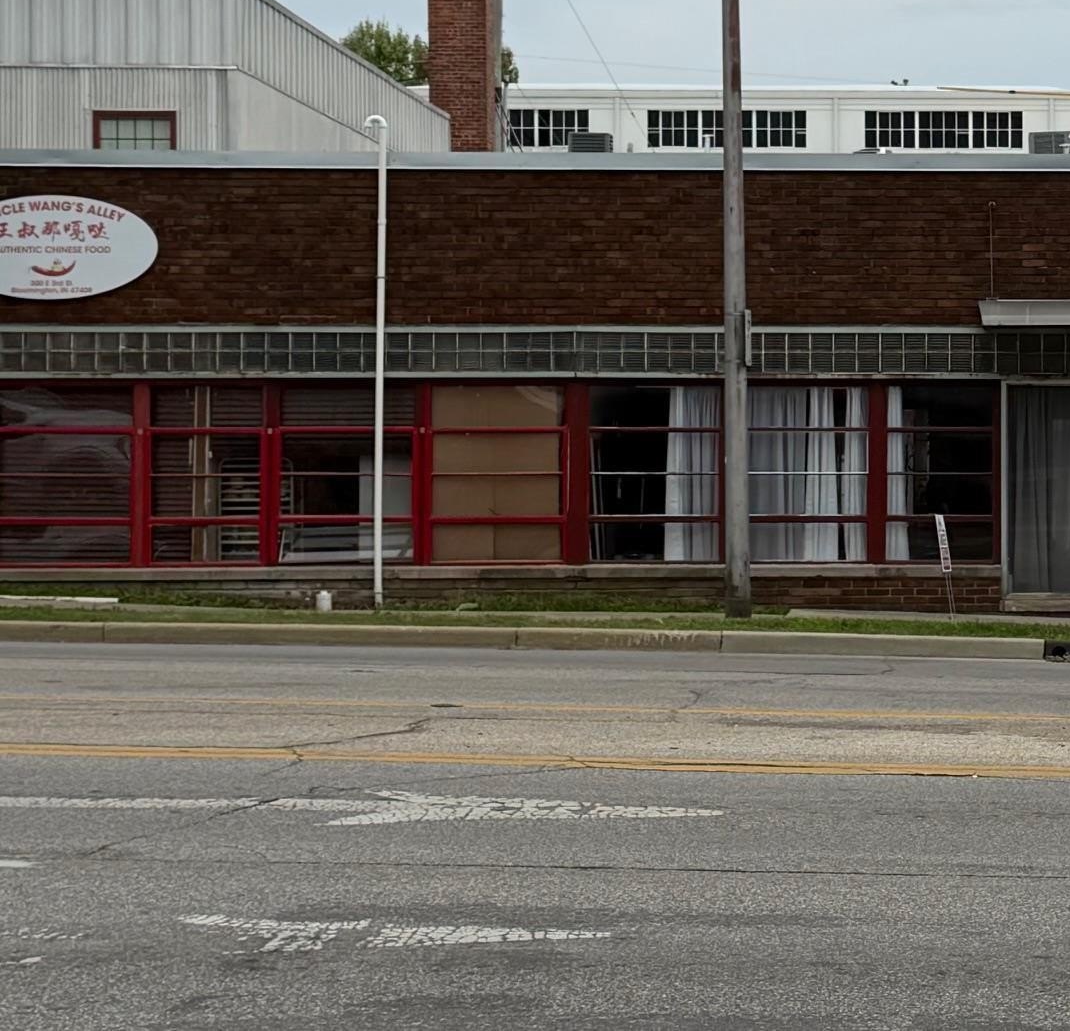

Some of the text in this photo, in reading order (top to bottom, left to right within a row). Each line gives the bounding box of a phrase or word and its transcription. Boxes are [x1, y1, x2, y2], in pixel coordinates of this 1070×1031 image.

[0, 201, 125, 222] CLE WANG'S ALLEY
[0, 246, 111, 254] UTHENTIC CHINESE FOOD
